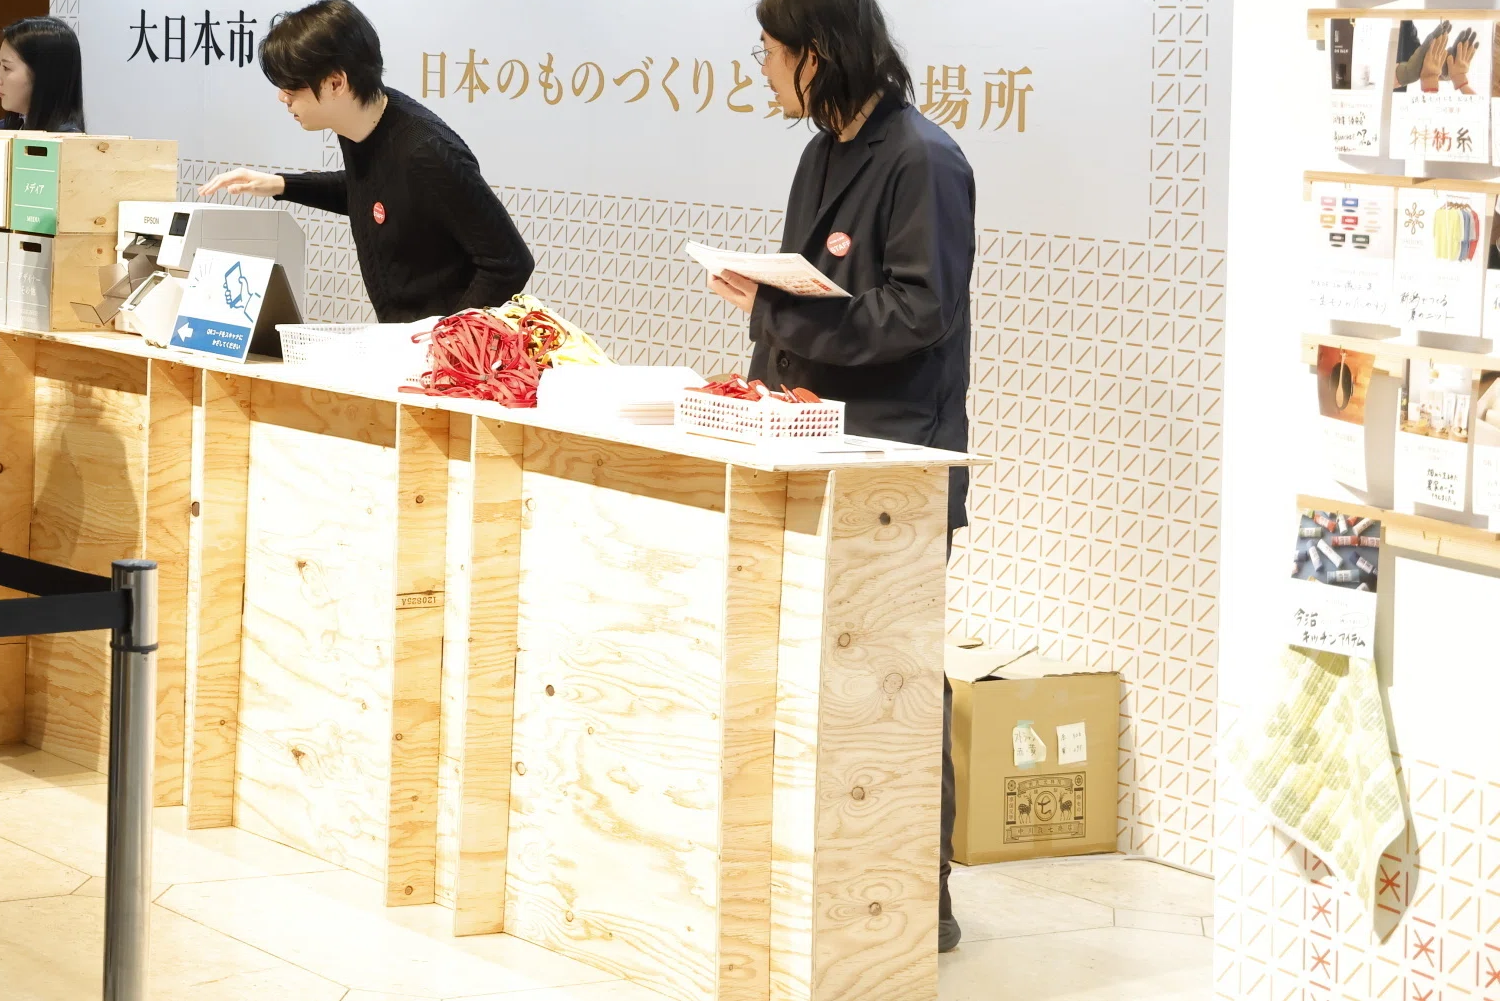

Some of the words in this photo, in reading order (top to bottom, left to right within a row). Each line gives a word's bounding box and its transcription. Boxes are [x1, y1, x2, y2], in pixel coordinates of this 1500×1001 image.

[127, 8, 257, 68] 大日本市
[23, 182, 45, 195] メディア
[143, 216, 160, 225] EPSON
[830, 239, 851, 253] STAFF
[211, 339, 241, 349] かざしてください
[1293, 607, 1319, 628] 今治
[1302, 630, 1367, 648] キッチンアイテム
